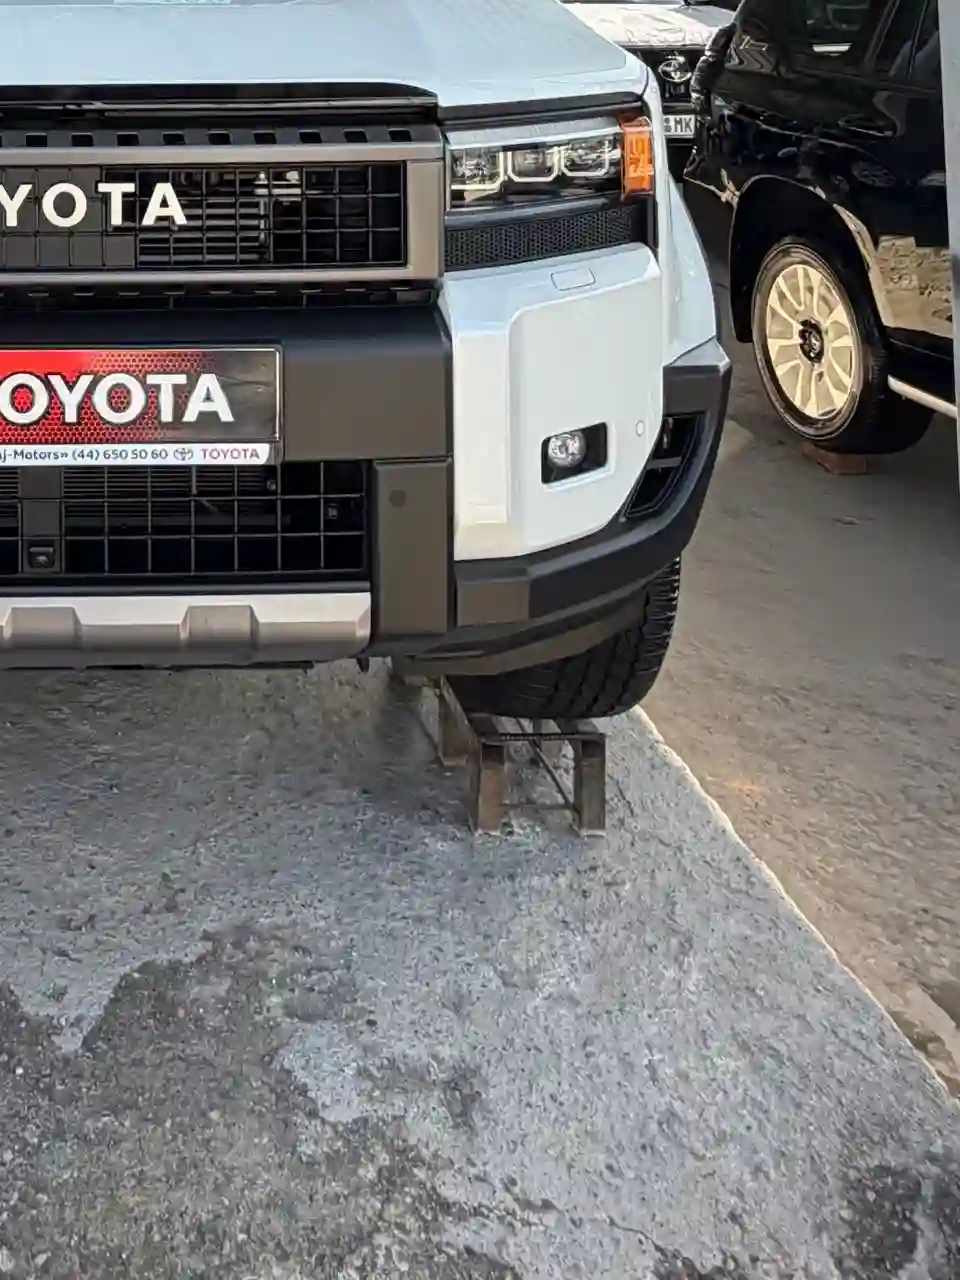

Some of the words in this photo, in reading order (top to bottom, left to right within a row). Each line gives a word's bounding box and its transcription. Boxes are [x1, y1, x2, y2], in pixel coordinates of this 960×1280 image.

[72, 447, 100, 461] (44)
[103, 448, 128, 460] 650
[131, 448, 148, 460] 50
[151, 448, 168, 460] 60
[201, 448, 260, 460] TOYOTA
